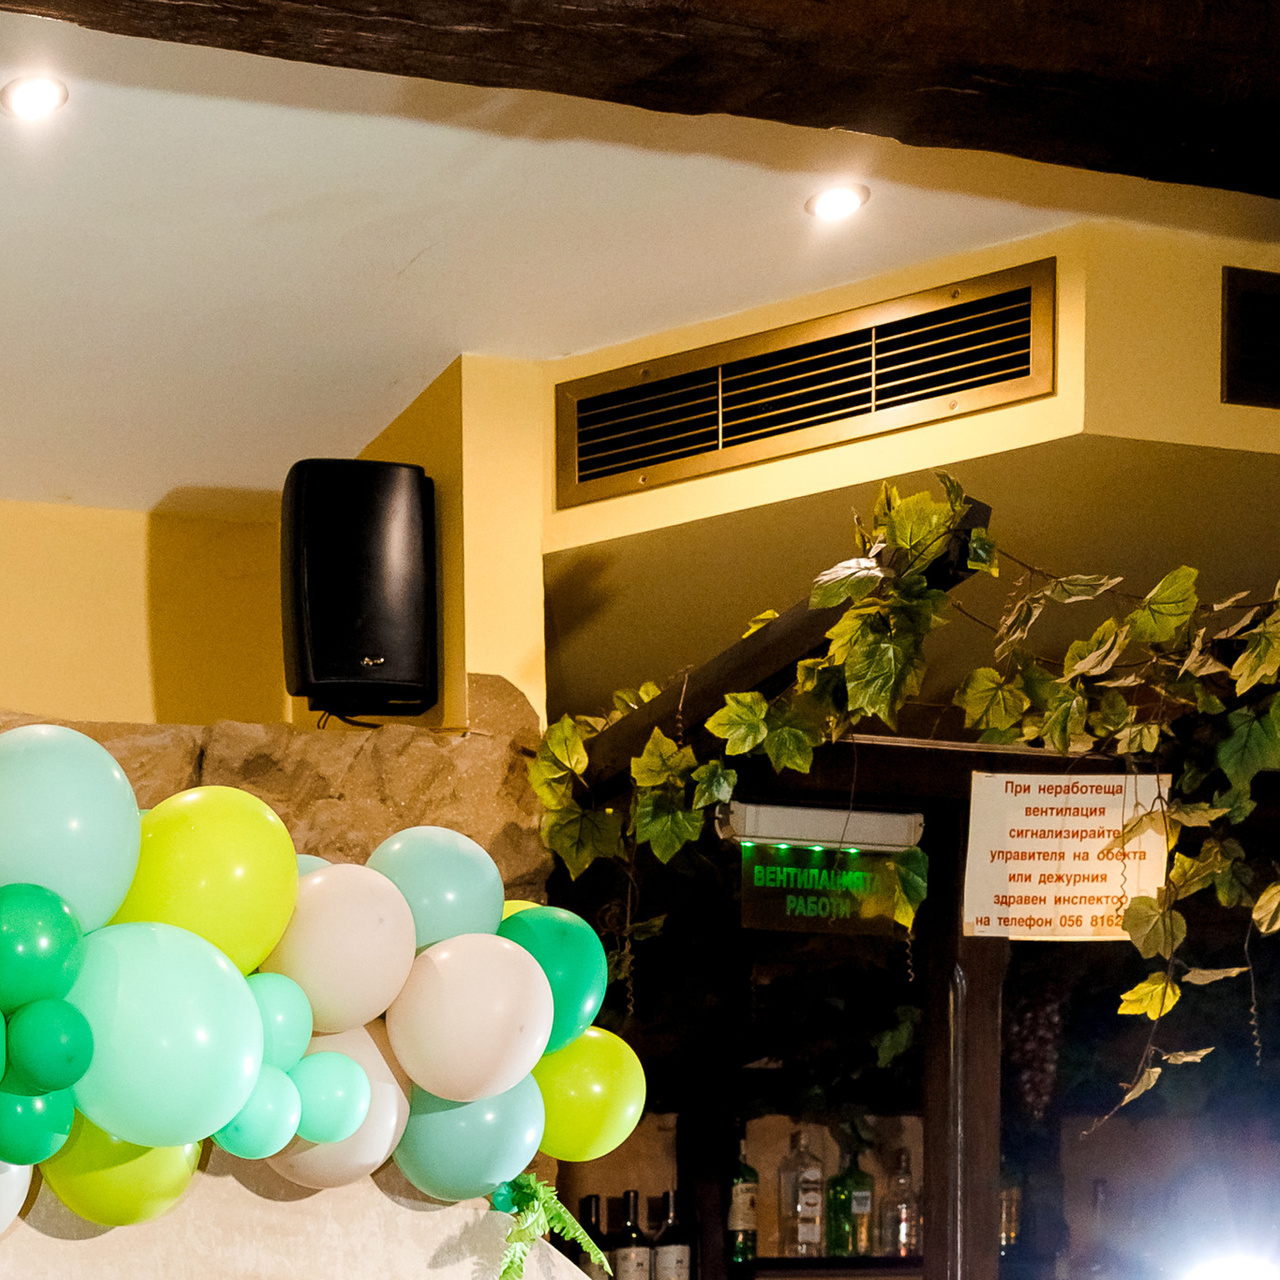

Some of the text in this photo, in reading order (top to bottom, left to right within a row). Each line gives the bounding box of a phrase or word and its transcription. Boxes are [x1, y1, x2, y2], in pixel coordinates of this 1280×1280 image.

[1004, 780, 1124, 797] При неработеща
[1024, 806, 1106, 818] вентилация
[1008, 827, 1121, 842] сигнализирайте
[990, 849, 1146, 863] управителя на обекта
[1008, 872, 1108, 886] или дежурния
[786, 894, 851, 919] РАБОТИ
[993, 894, 1047, 907] здравен
[976, 915, 1124, 929] на телефон 056 8162
